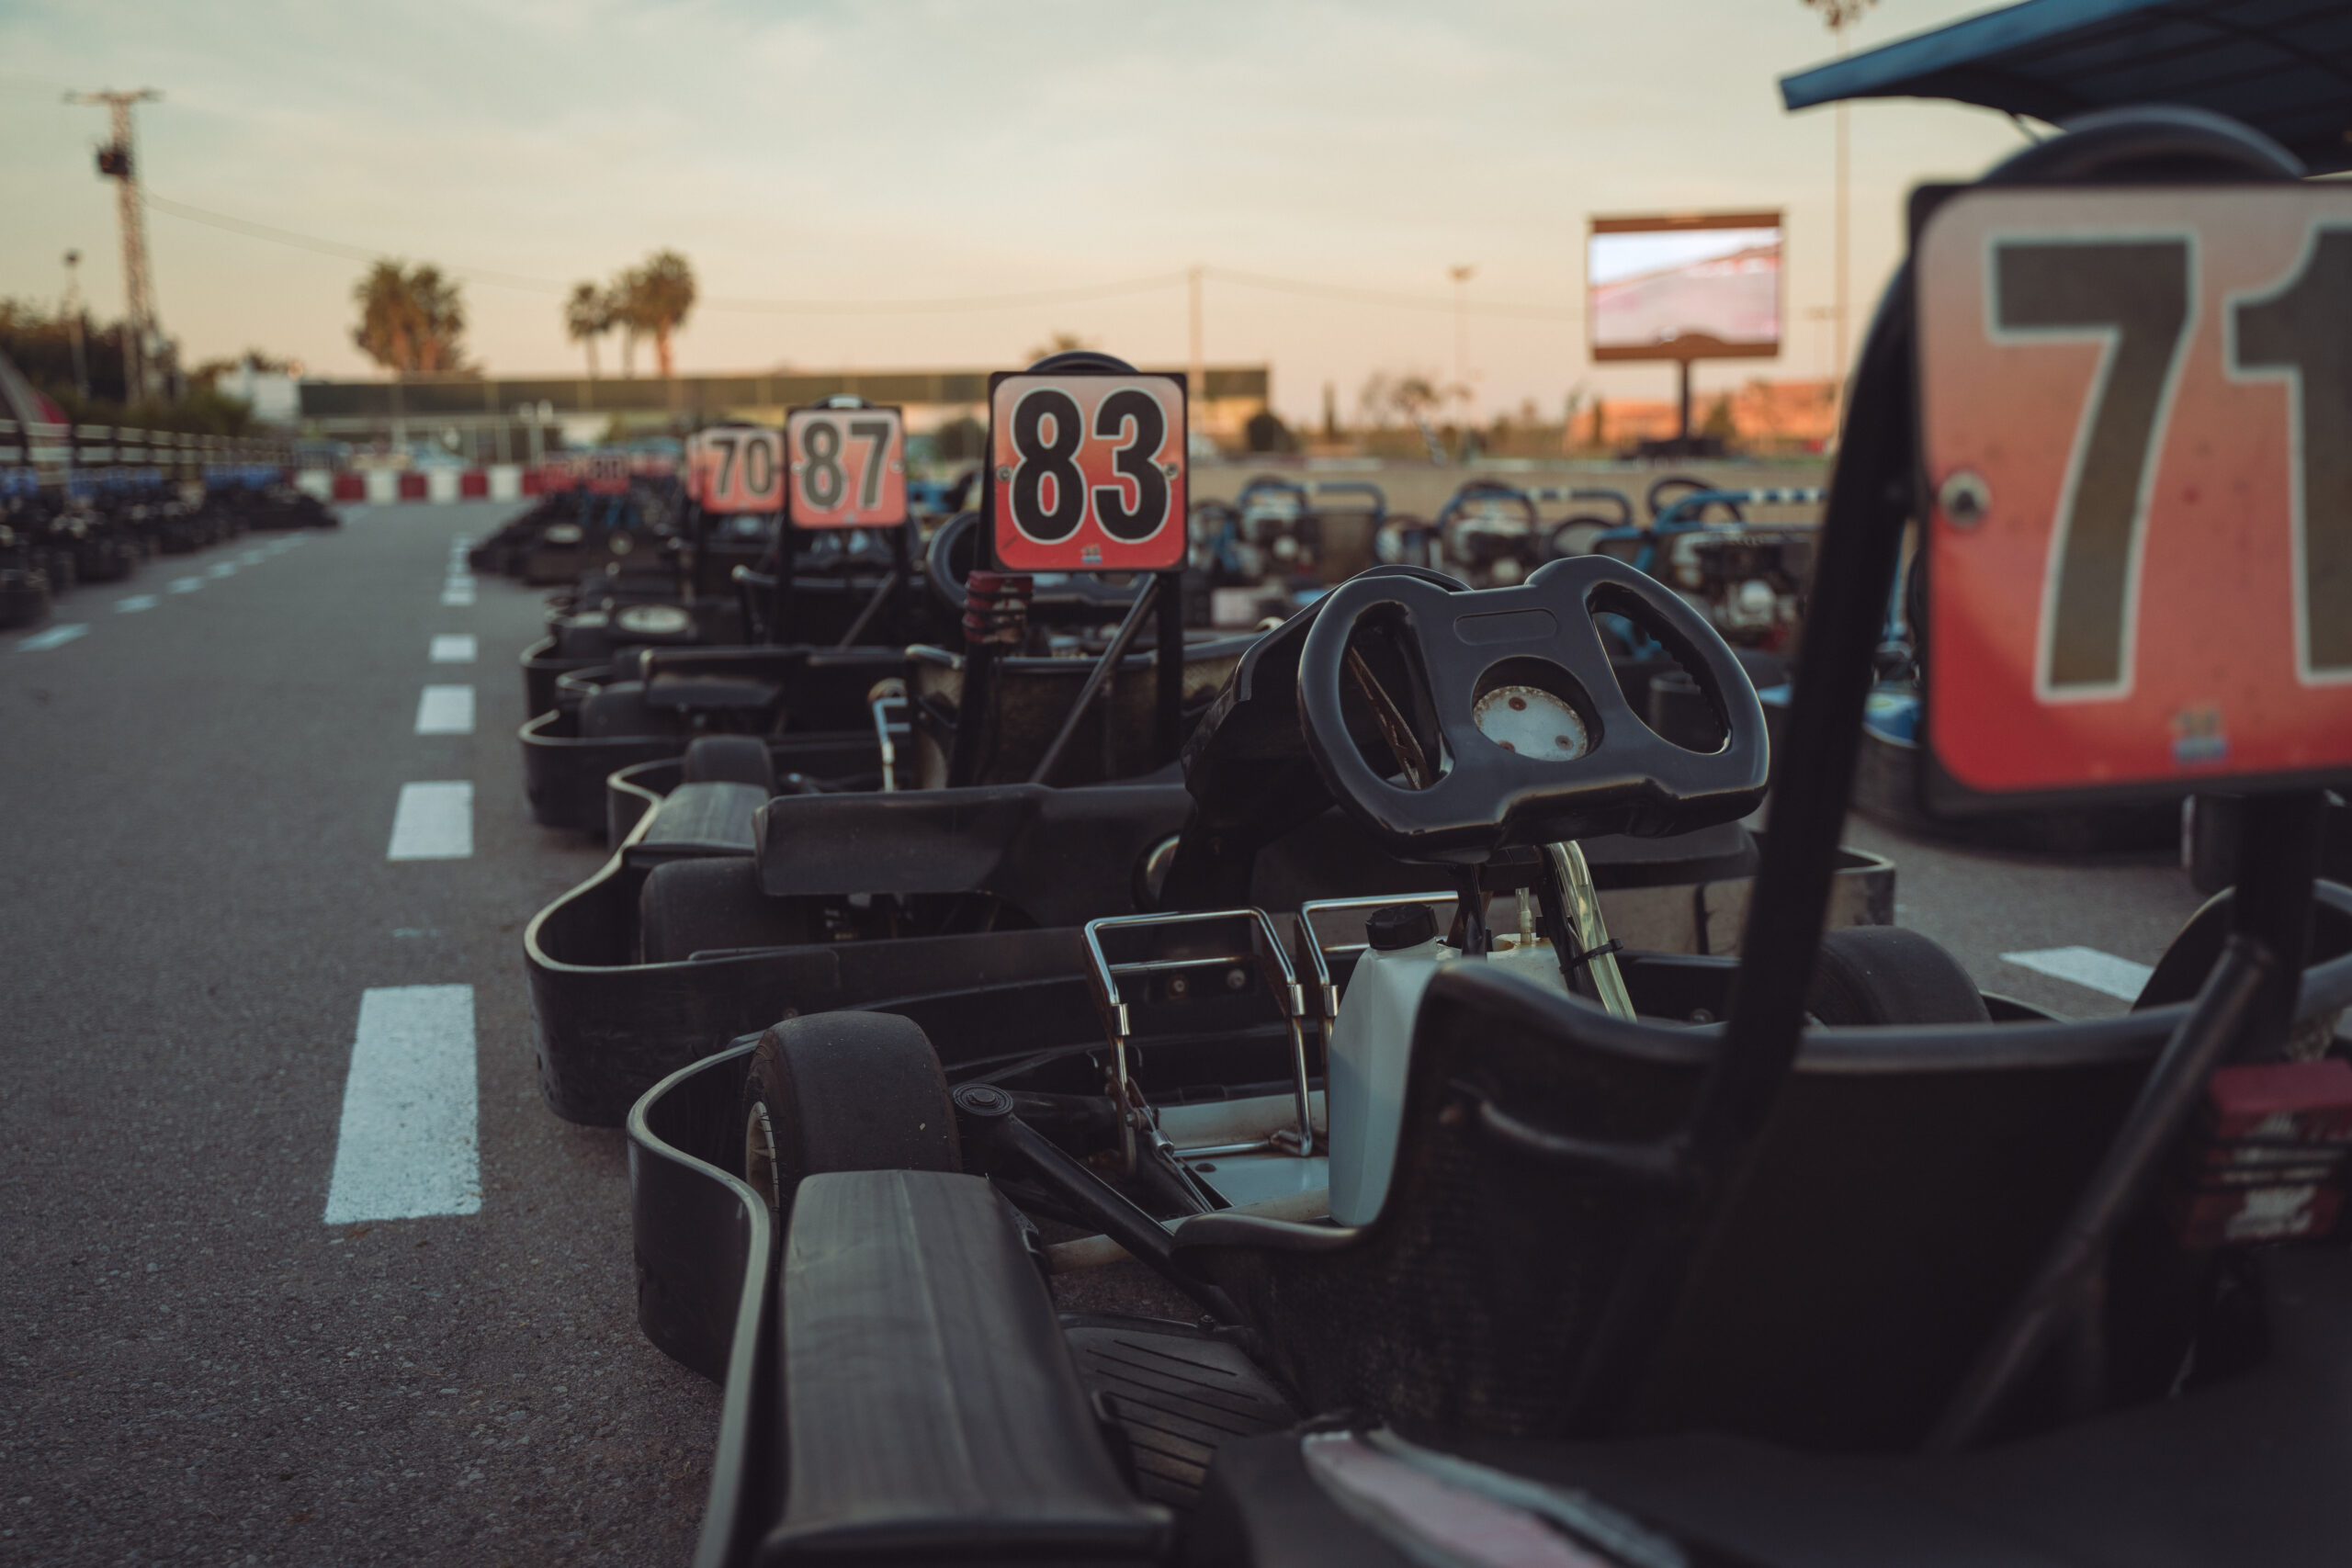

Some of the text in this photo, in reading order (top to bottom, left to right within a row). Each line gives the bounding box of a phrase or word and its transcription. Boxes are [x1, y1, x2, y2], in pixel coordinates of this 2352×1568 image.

[710, 435, 776, 499] 70
[800, 418, 893, 513] 87
[1010, 387, 1171, 545] 83
[1984, 223, 2352, 703] 71
